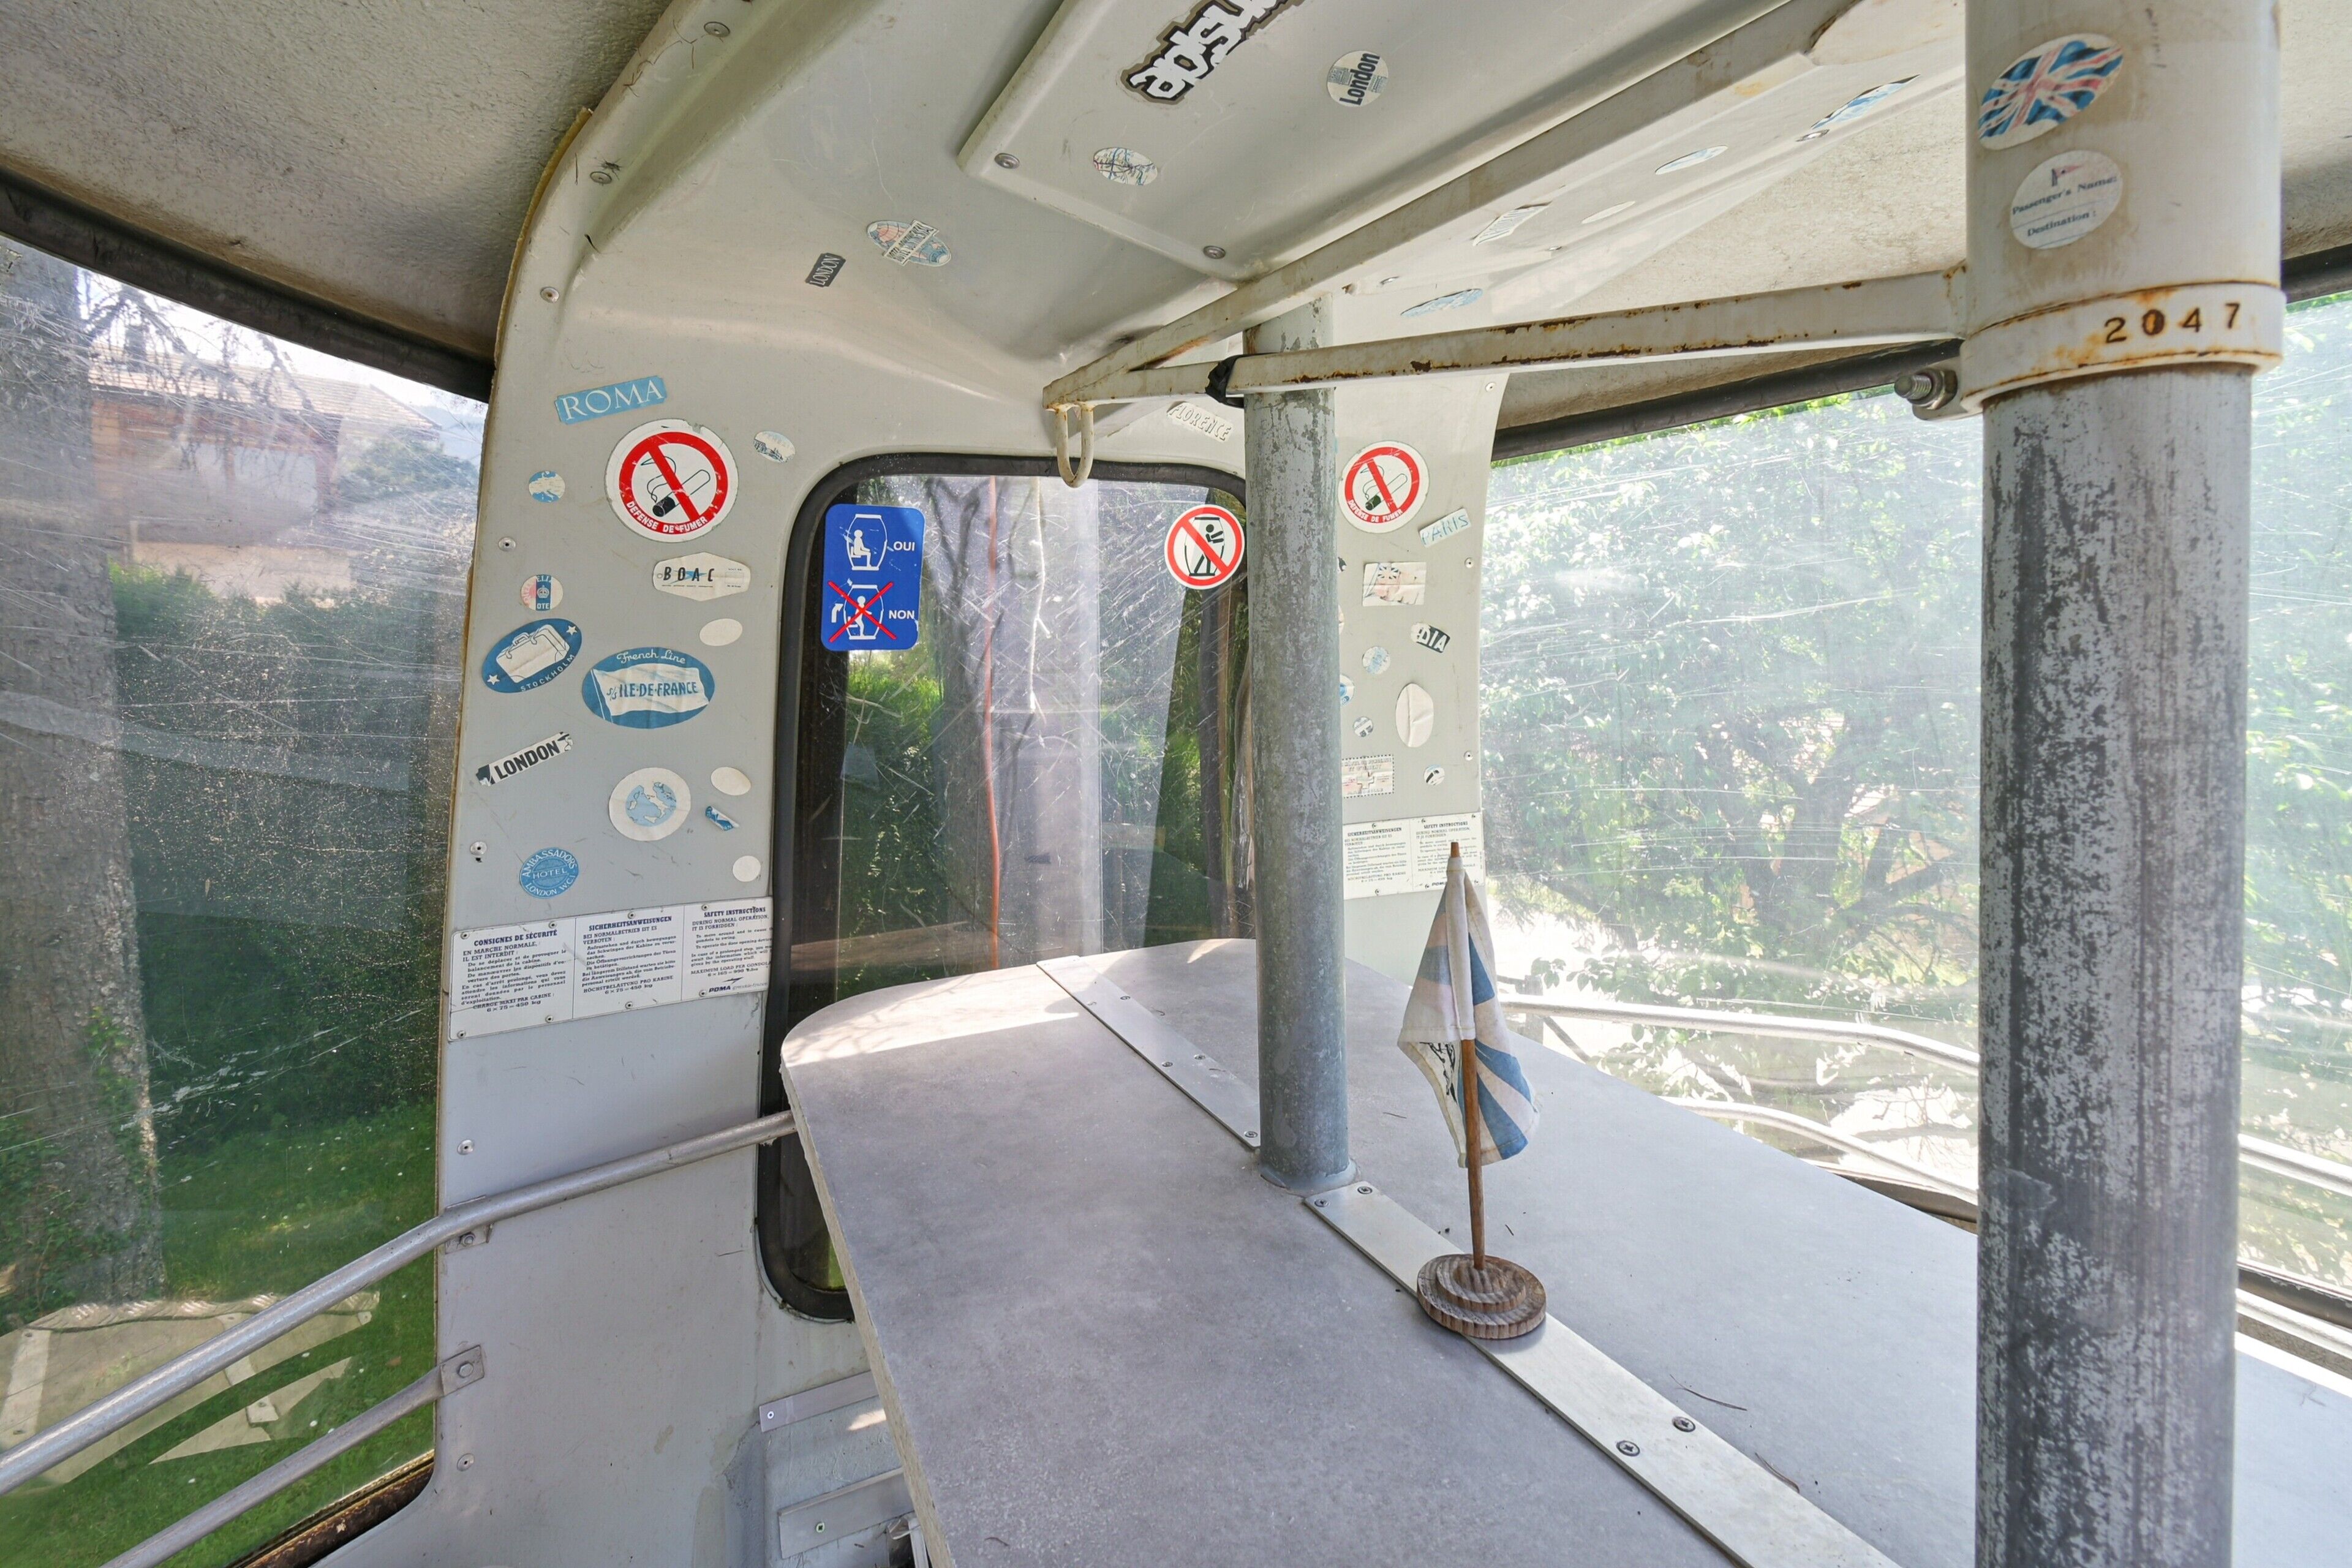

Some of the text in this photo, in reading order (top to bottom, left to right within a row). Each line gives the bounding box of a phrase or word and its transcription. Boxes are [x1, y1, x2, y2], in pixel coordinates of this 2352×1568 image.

[1340, 53, 1380, 105] London
[2013, 176, 2117, 214] Passenger's Name:
[2027, 211, 2090, 236] Destination
[810, 255, 840, 285] LONDON
[2105, 303, 2241, 344] 2047
[562, 379, 665, 421] ROMA
[1169, 404, 1232, 441] FLORENCE
[627, 500, 708, 534] DEFENSE DE FUMER
[1382, 508, 1403, 522] FUMER
[1422, 514, 1469, 545] PARIS
[893, 541, 915, 551] OUI
[663, 567, 715, 582] BOAC
[889, 609, 914, 619] NON
[617, 649, 686, 665] French Line
[520, 654, 576, 693] STOCKHOLM
[495, 739, 562, 780] LONDON
[522, 849, 578, 878] AMBASSADORS
[533, 868, 568, 880] HOTEL
[726, 906, 766, 915] INSTRUCTIONS
[588, 916, 672, 931] SICHERHEITSANWEISUNGEN
[594, 928, 640, 938] NORMALBETRIEB
[473, 935, 513, 946] CONSIGNES
[526, 929, 557, 940] SÉCURITÉ
[473, 946, 503, 954] MARCHE
[484, 951, 514, 959] INTERDIT
